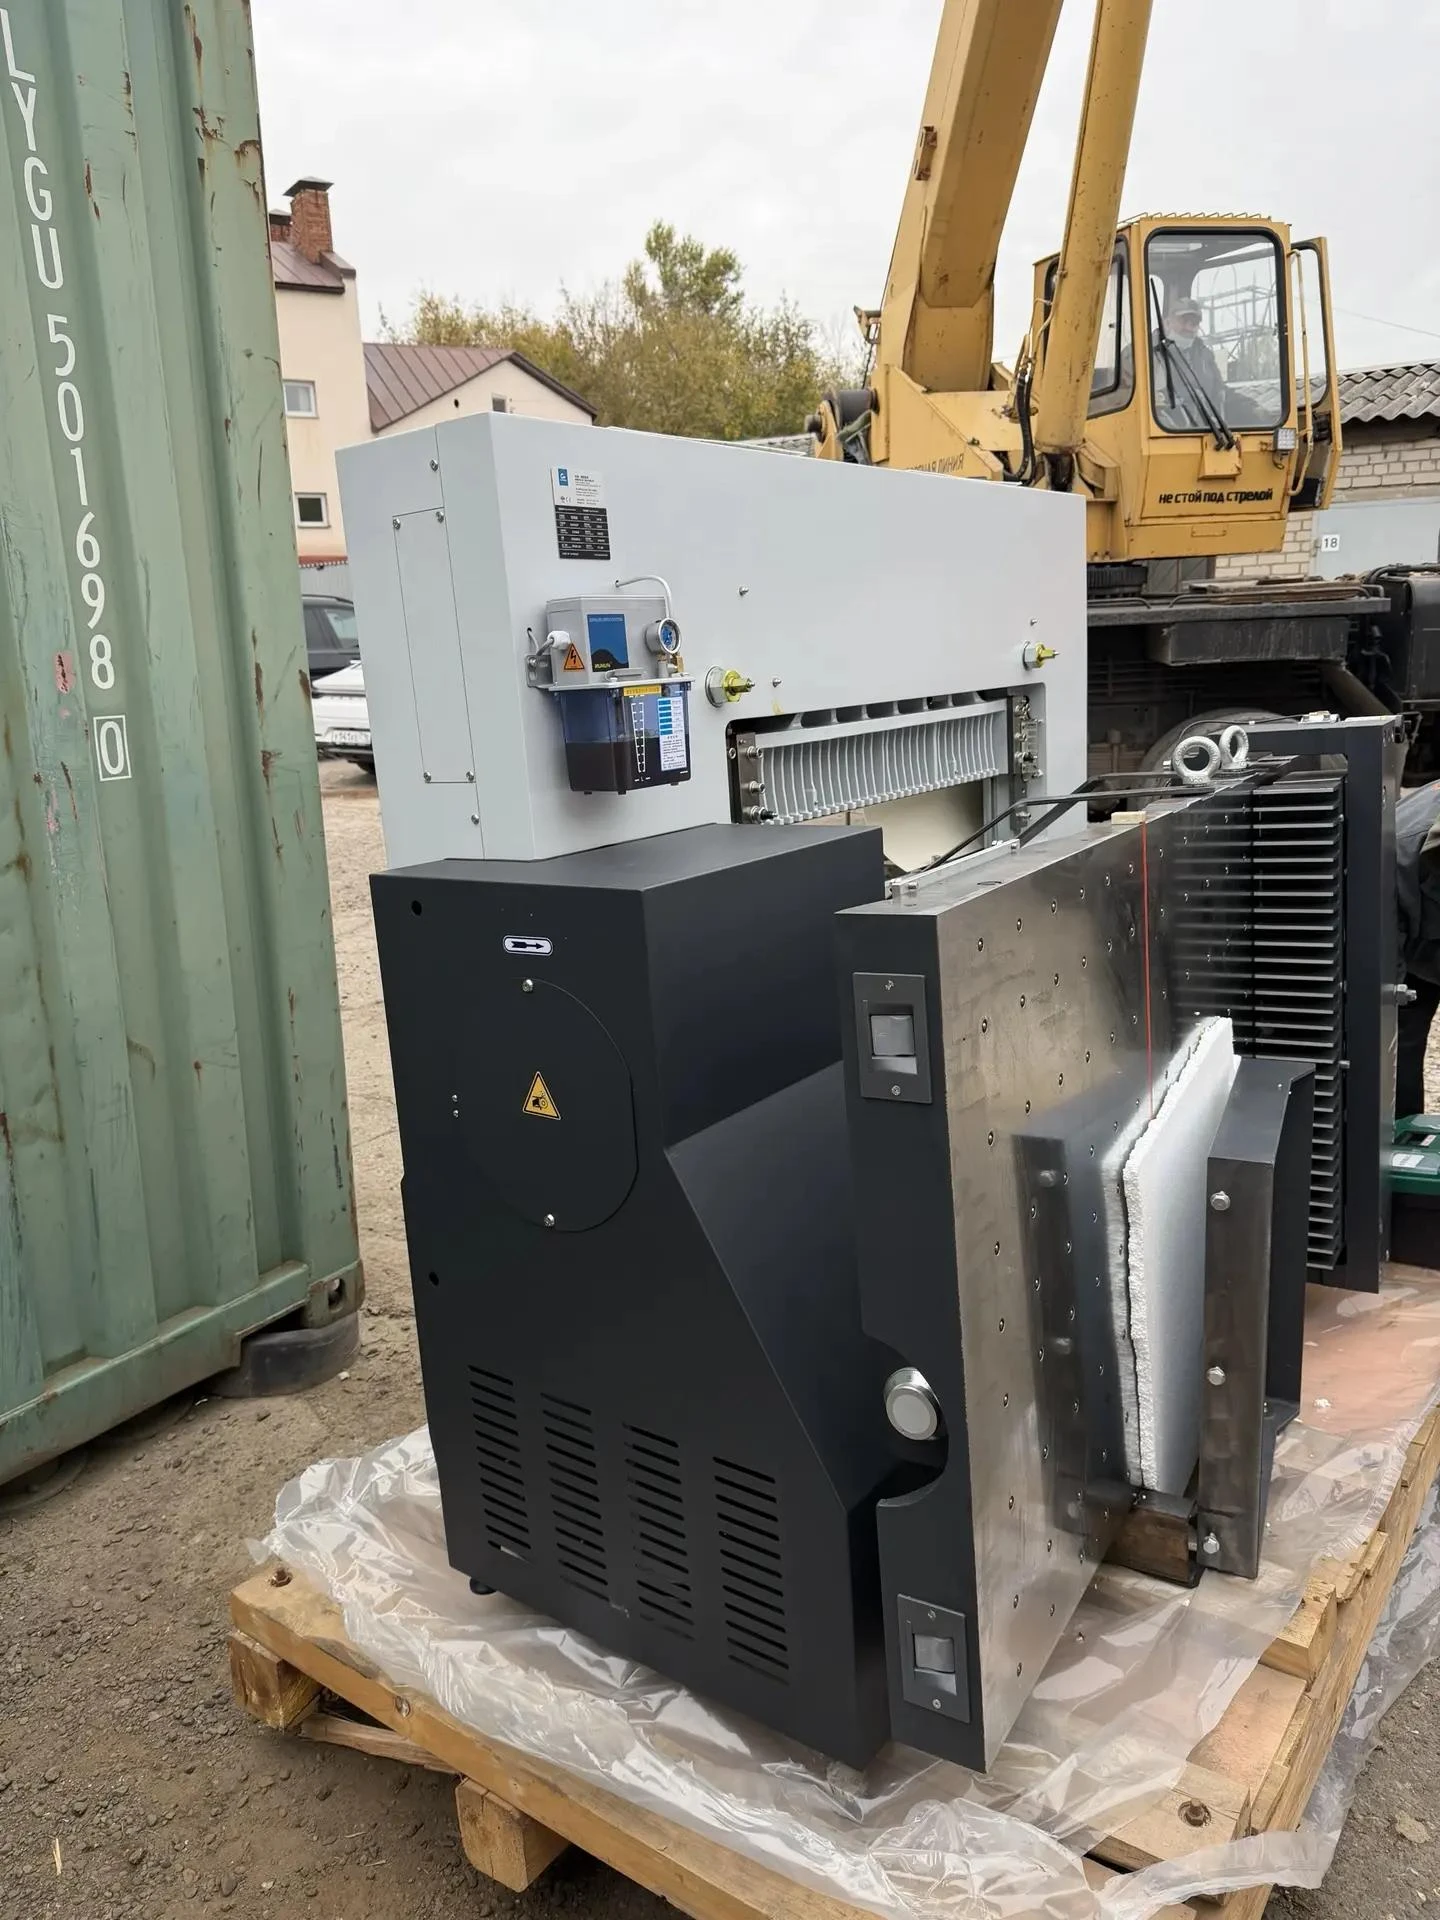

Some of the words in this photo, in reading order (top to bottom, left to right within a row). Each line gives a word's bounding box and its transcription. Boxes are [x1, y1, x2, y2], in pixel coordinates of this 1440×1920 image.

[0, 8, 64, 289] LYGU
[47, 314, 115, 690] 501698
[100, 721, 126, 775] 0
[1324, 537, 1338, 548] 18
